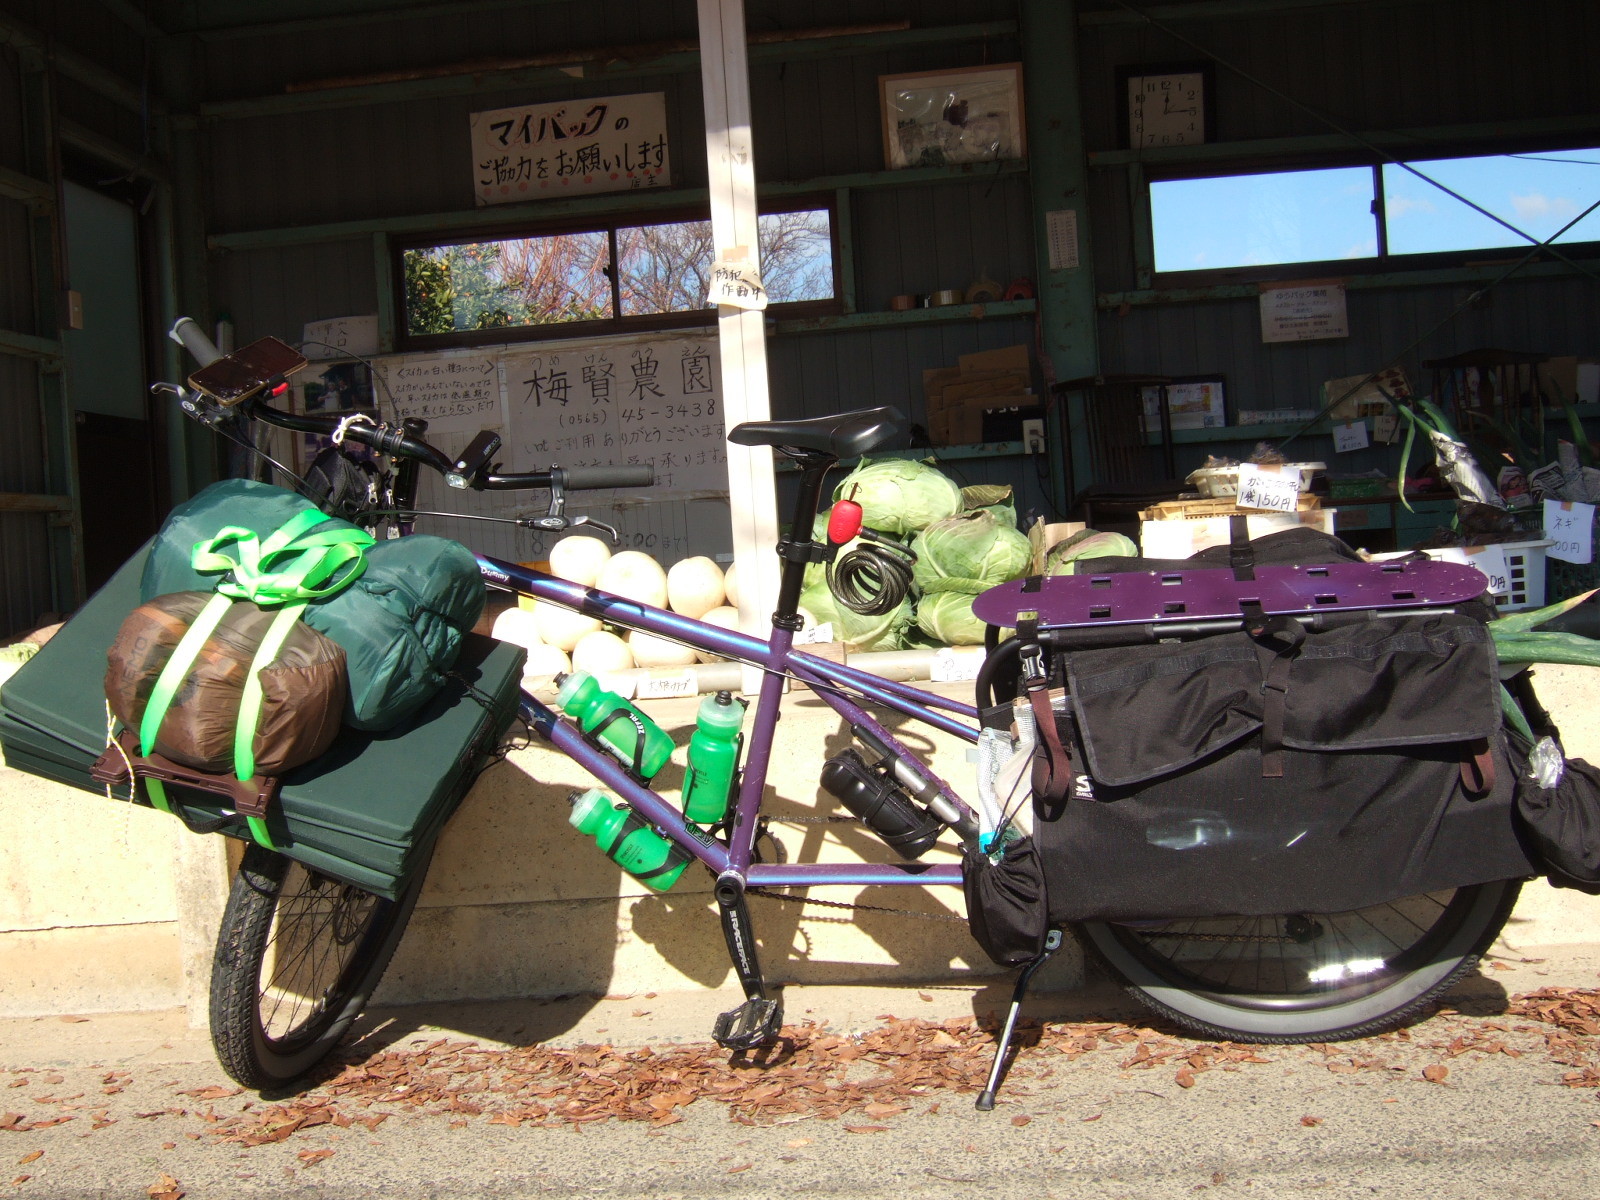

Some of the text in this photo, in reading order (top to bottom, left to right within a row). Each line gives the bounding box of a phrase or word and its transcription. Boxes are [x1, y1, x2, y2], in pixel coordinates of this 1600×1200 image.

[480, 133, 667, 186] ご協力をお願いします
[523, 354, 713, 407] 梅賢農園
[559, 398, 715, 428] (0565) 45-3438
[1551, 540, 1580, 553] 00円
